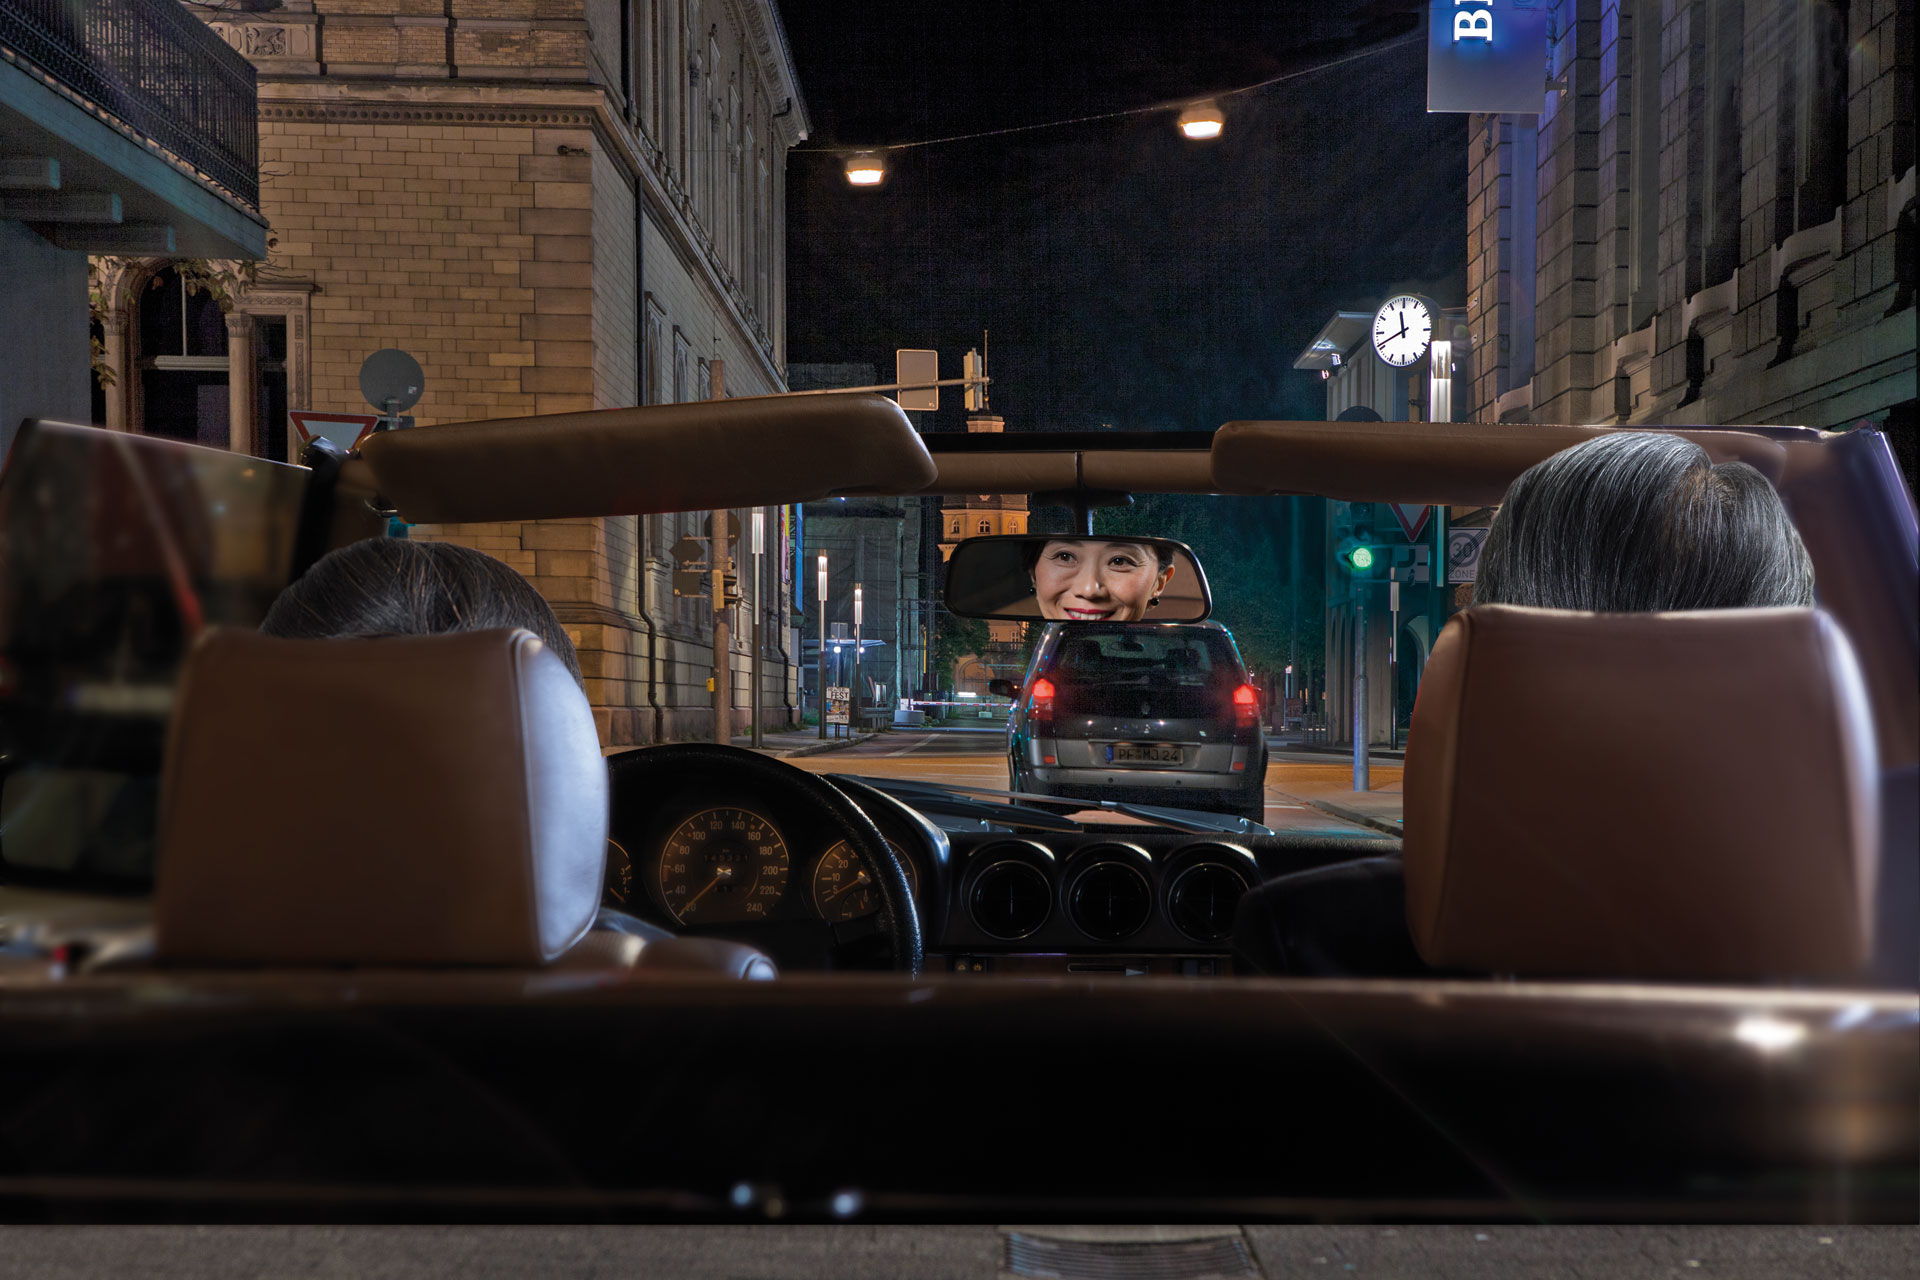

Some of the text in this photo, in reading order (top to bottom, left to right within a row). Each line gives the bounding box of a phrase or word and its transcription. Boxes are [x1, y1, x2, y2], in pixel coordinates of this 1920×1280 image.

[1453, 0, 1493, 42] B
[1449, 569, 1475, 579] ZONE
[831, 691, 848, 699] FEST
[1119, 748, 1134, 761] PF
[1162, 750, 1178, 761] 24
[710, 821, 723, 830] 120
[732, 821, 745, 830] 140
[692, 831, 706, 841] 100
[747, 831, 761, 841] 160
[679, 845, 690, 855] 80
[759, 846, 773, 856] 180
[674, 864, 686, 873] 60
[838, 859, 849, 869] 20
[762, 865, 778, 875] 200
[832, 872, 841, 882] 10
[674, 884, 687, 895] 40
[760, 884, 775, 895] 220
[832, 885, 838, 894] 5
[746, 902, 763, 912] 240
